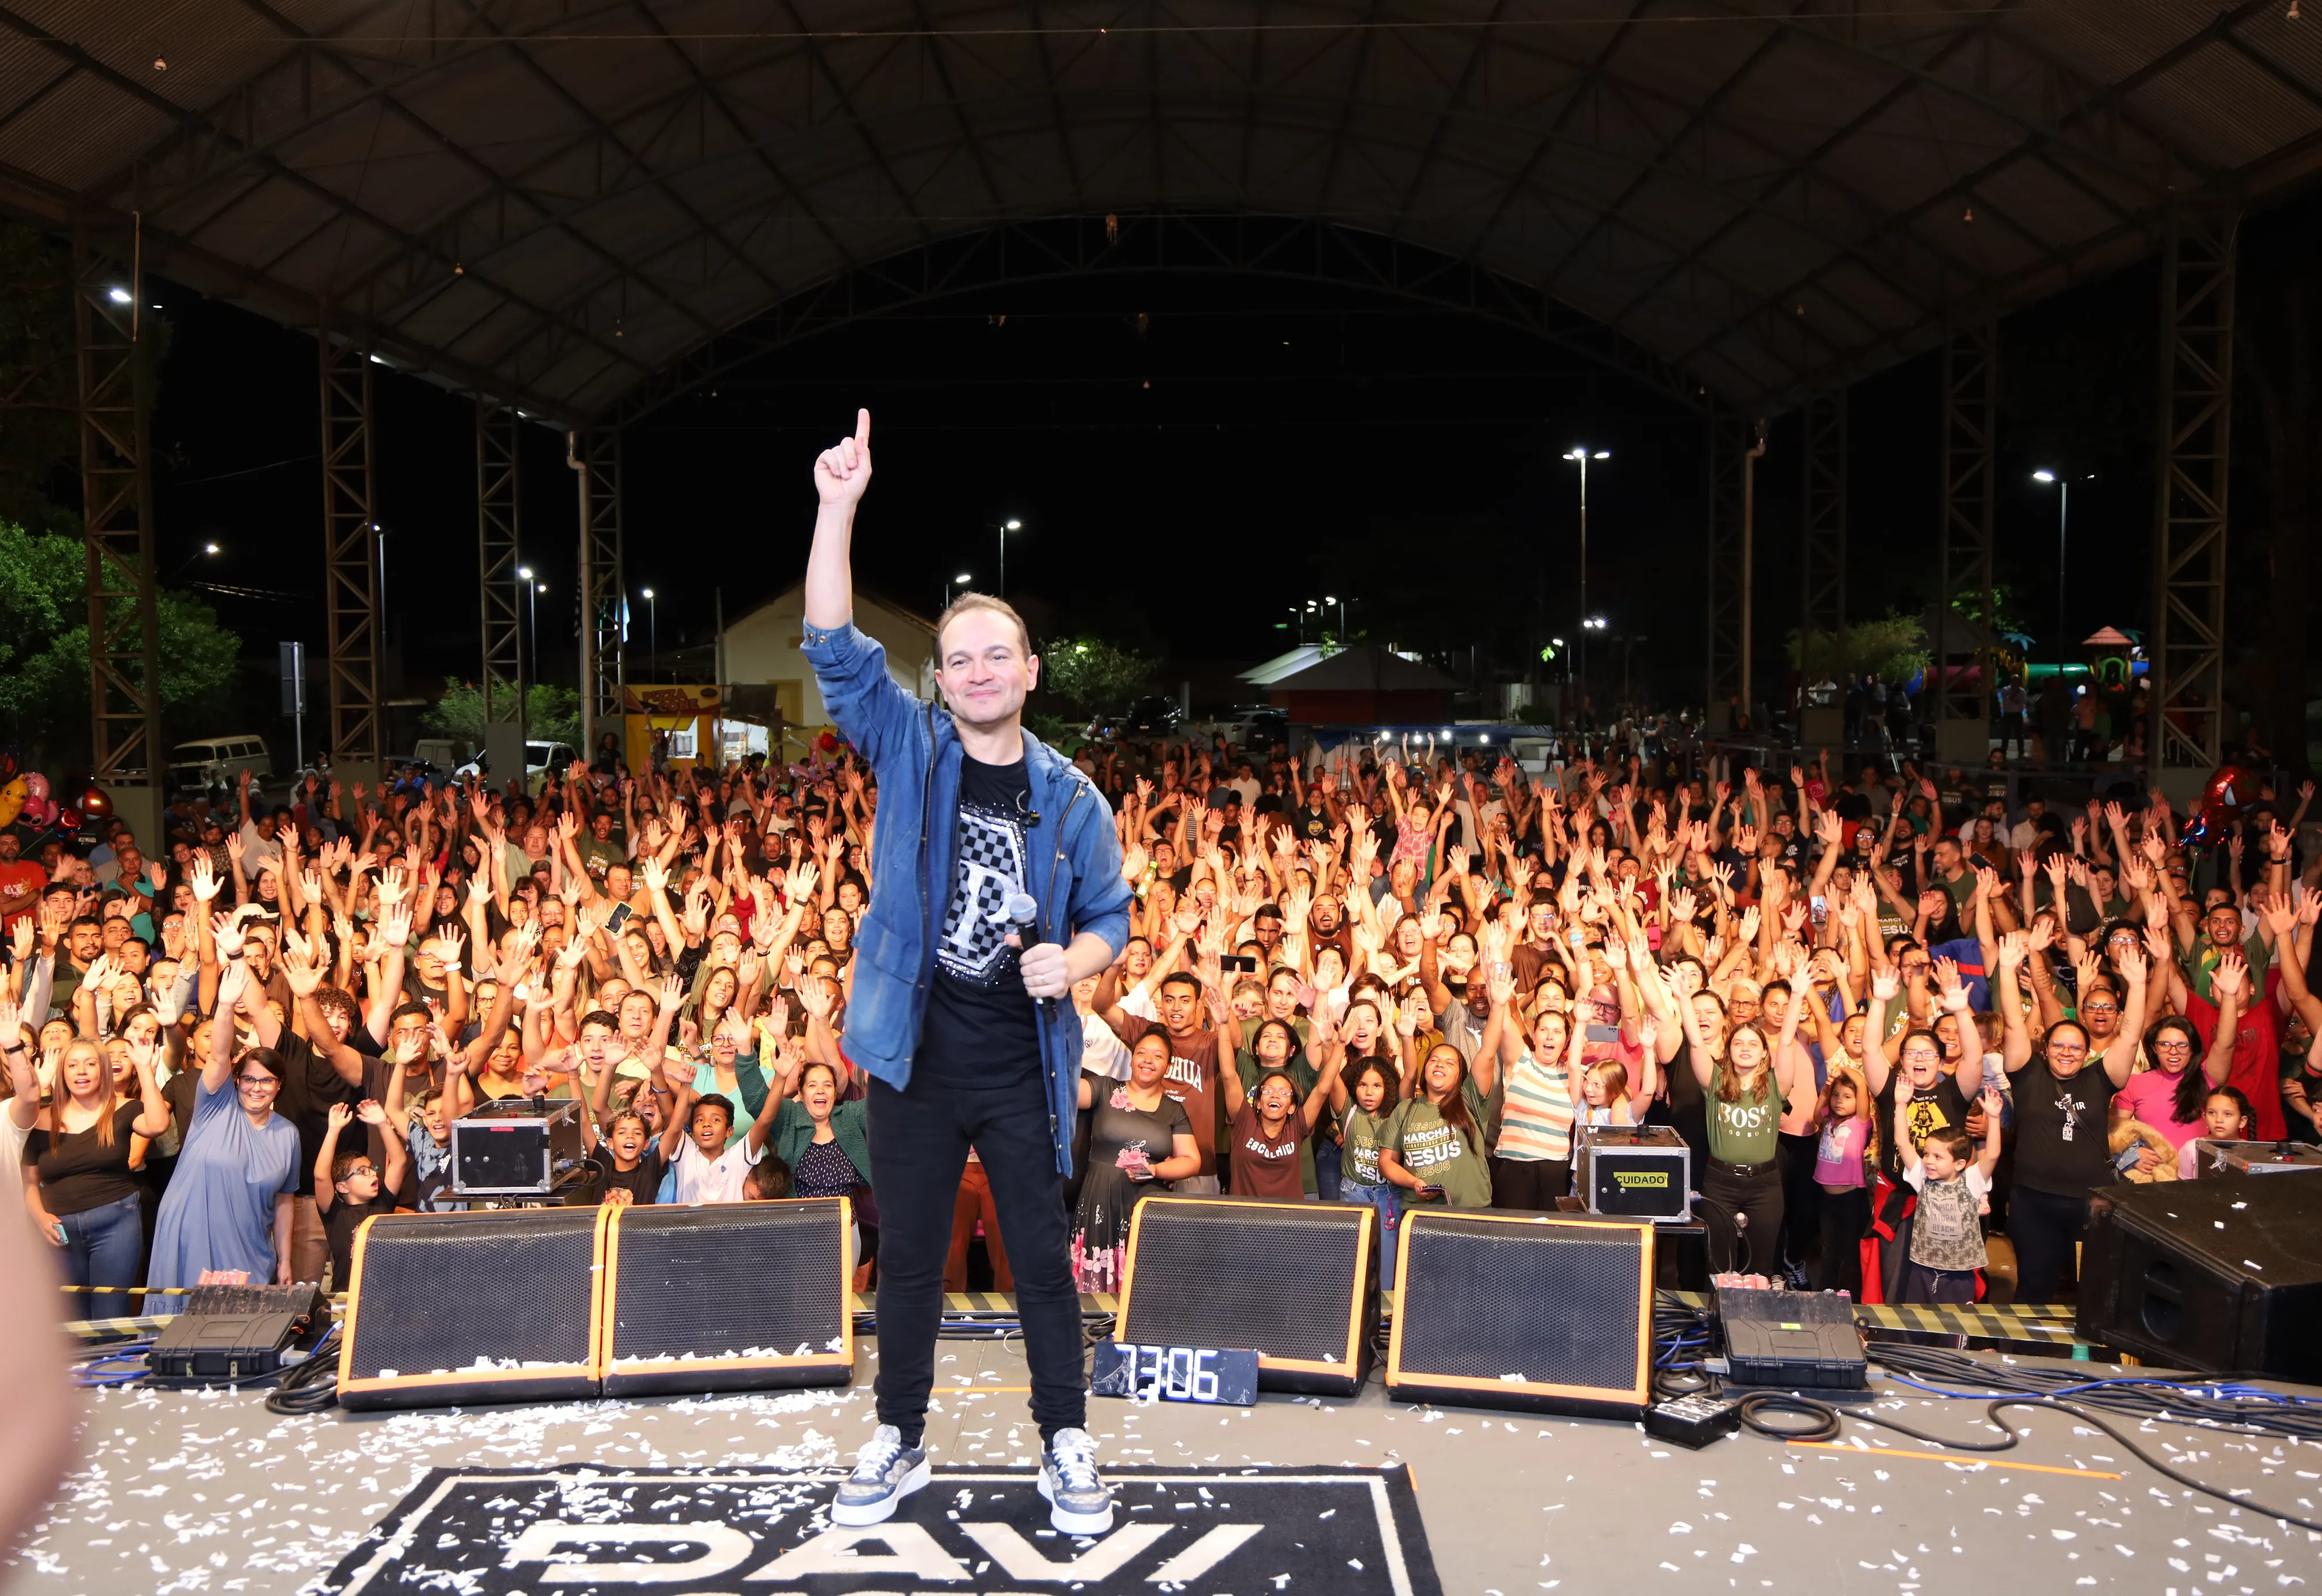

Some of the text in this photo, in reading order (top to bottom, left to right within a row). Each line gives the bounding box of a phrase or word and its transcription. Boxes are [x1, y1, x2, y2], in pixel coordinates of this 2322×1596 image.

[642, 688, 687, 702] PIZZA
[657, 698, 700, 712] CONE
[1408, 1119, 1443, 1132] JESUS
[1404, 1126, 1449, 1143] MARCHA
[1355, 1135, 1380, 1150] JESU
[1405, 1140, 1461, 1167] JESUS
[1355, 1161, 1387, 1184] JESU
[1415, 1160, 1451, 1178] JESUS
[1615, 1176, 1665, 1184] CUIDADO
[1930, 1213, 1958, 1222] NATURAL
[1933, 1224, 1955, 1233] BEACH
[501, 1523, 1265, 1583] DAVI
